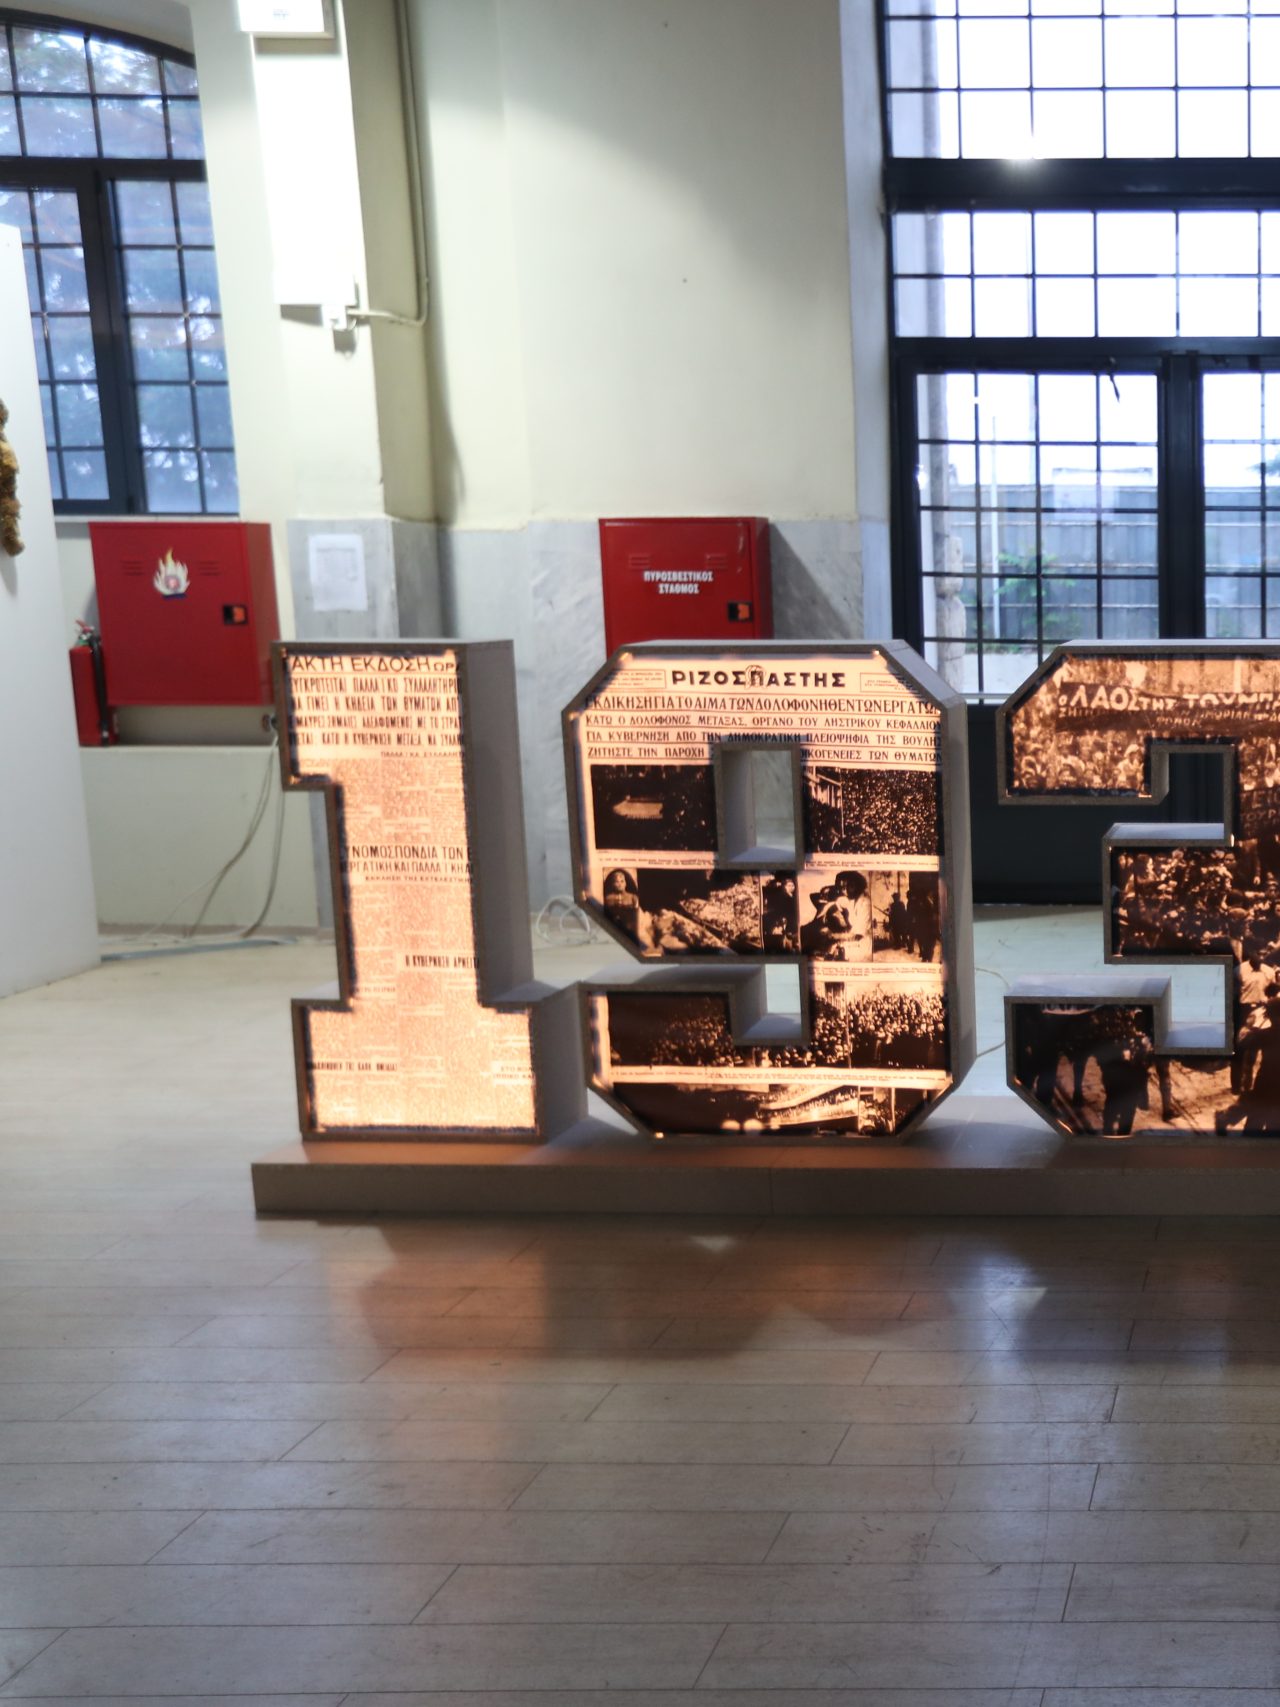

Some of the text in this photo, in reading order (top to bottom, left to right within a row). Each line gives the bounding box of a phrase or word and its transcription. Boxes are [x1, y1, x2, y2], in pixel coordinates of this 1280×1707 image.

[643, 571, 714, 582] ΠΥΡΟΣΒΕΣΤΙΚΟΣ
[658, 584, 699, 594] ΣΤΑΘΜΟΣ
[351, 656, 430, 672] ΕΚΔΟΣΗ
[671, 669, 846, 688] ΡΙΖΟΣΠΑΣΤΗΣ
